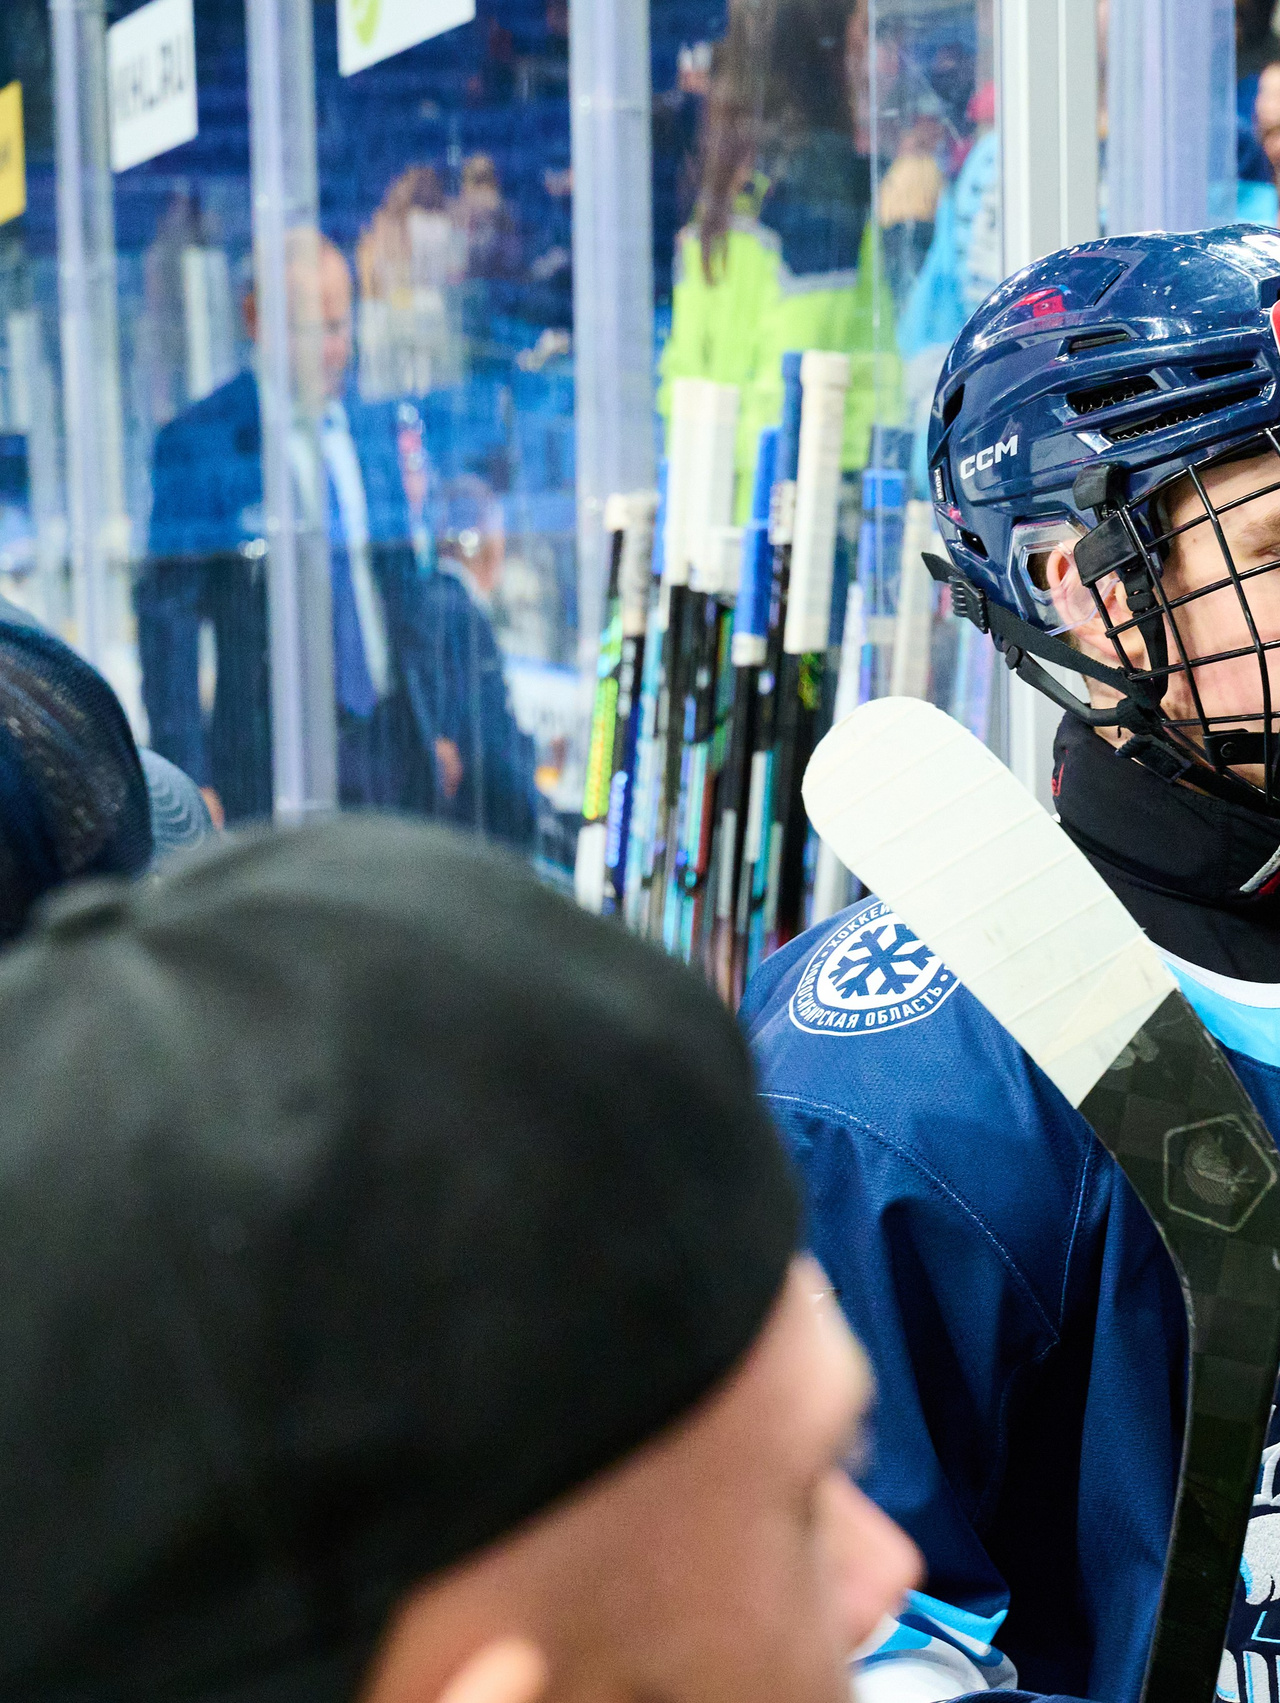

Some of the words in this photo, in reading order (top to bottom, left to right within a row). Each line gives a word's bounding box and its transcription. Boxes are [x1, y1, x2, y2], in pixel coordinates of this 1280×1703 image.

[960, 434, 1018, 480] CCM
[797, 960, 860, 1028] НОВОСИБИРСКАЯ
[865, 986, 943, 1027] ОБЛАСТЬ
